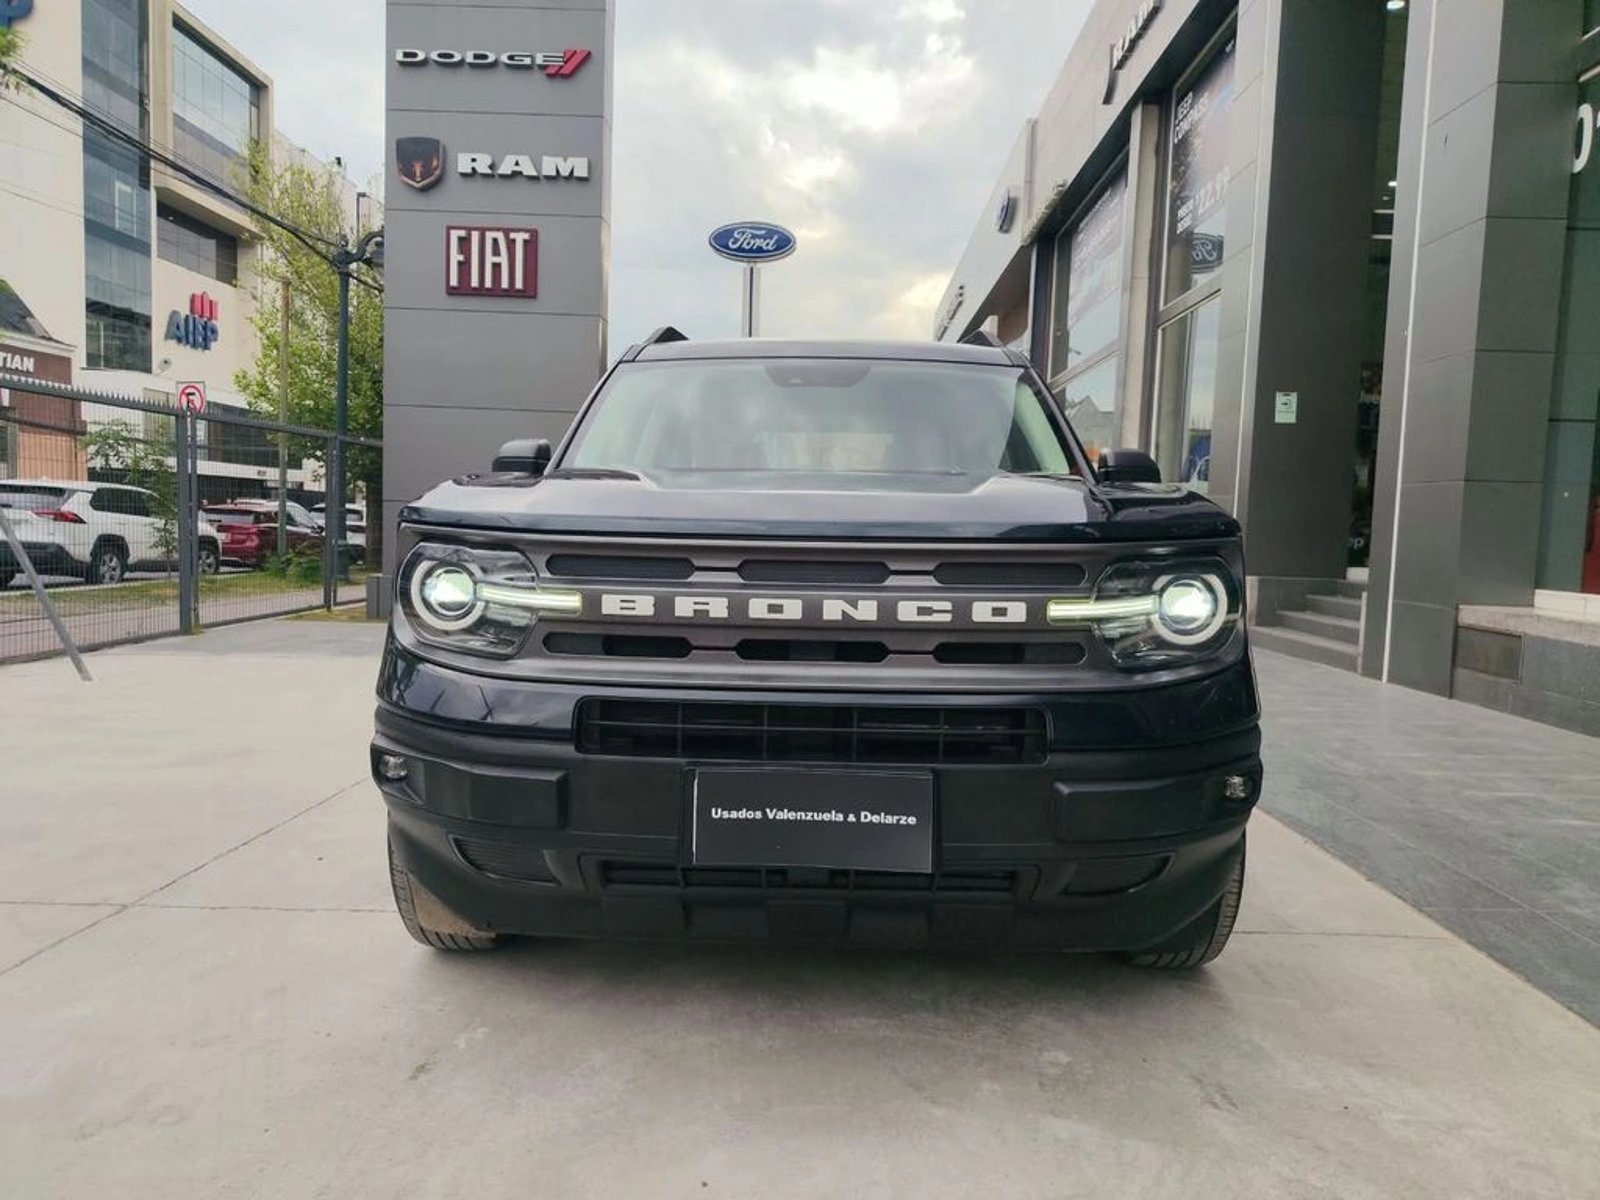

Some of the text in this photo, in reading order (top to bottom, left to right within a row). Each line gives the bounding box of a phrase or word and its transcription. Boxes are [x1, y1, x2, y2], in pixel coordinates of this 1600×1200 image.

[395, 49, 565, 67] DODGE
[457, 152, 589, 180] RAM
[728, 228, 778, 251] Ford
[449, 228, 532, 291] FIAT
[601, 594, 1027, 623] BRONCO
[711, 807, 917, 825] Usados Valenzuela & Delarze
